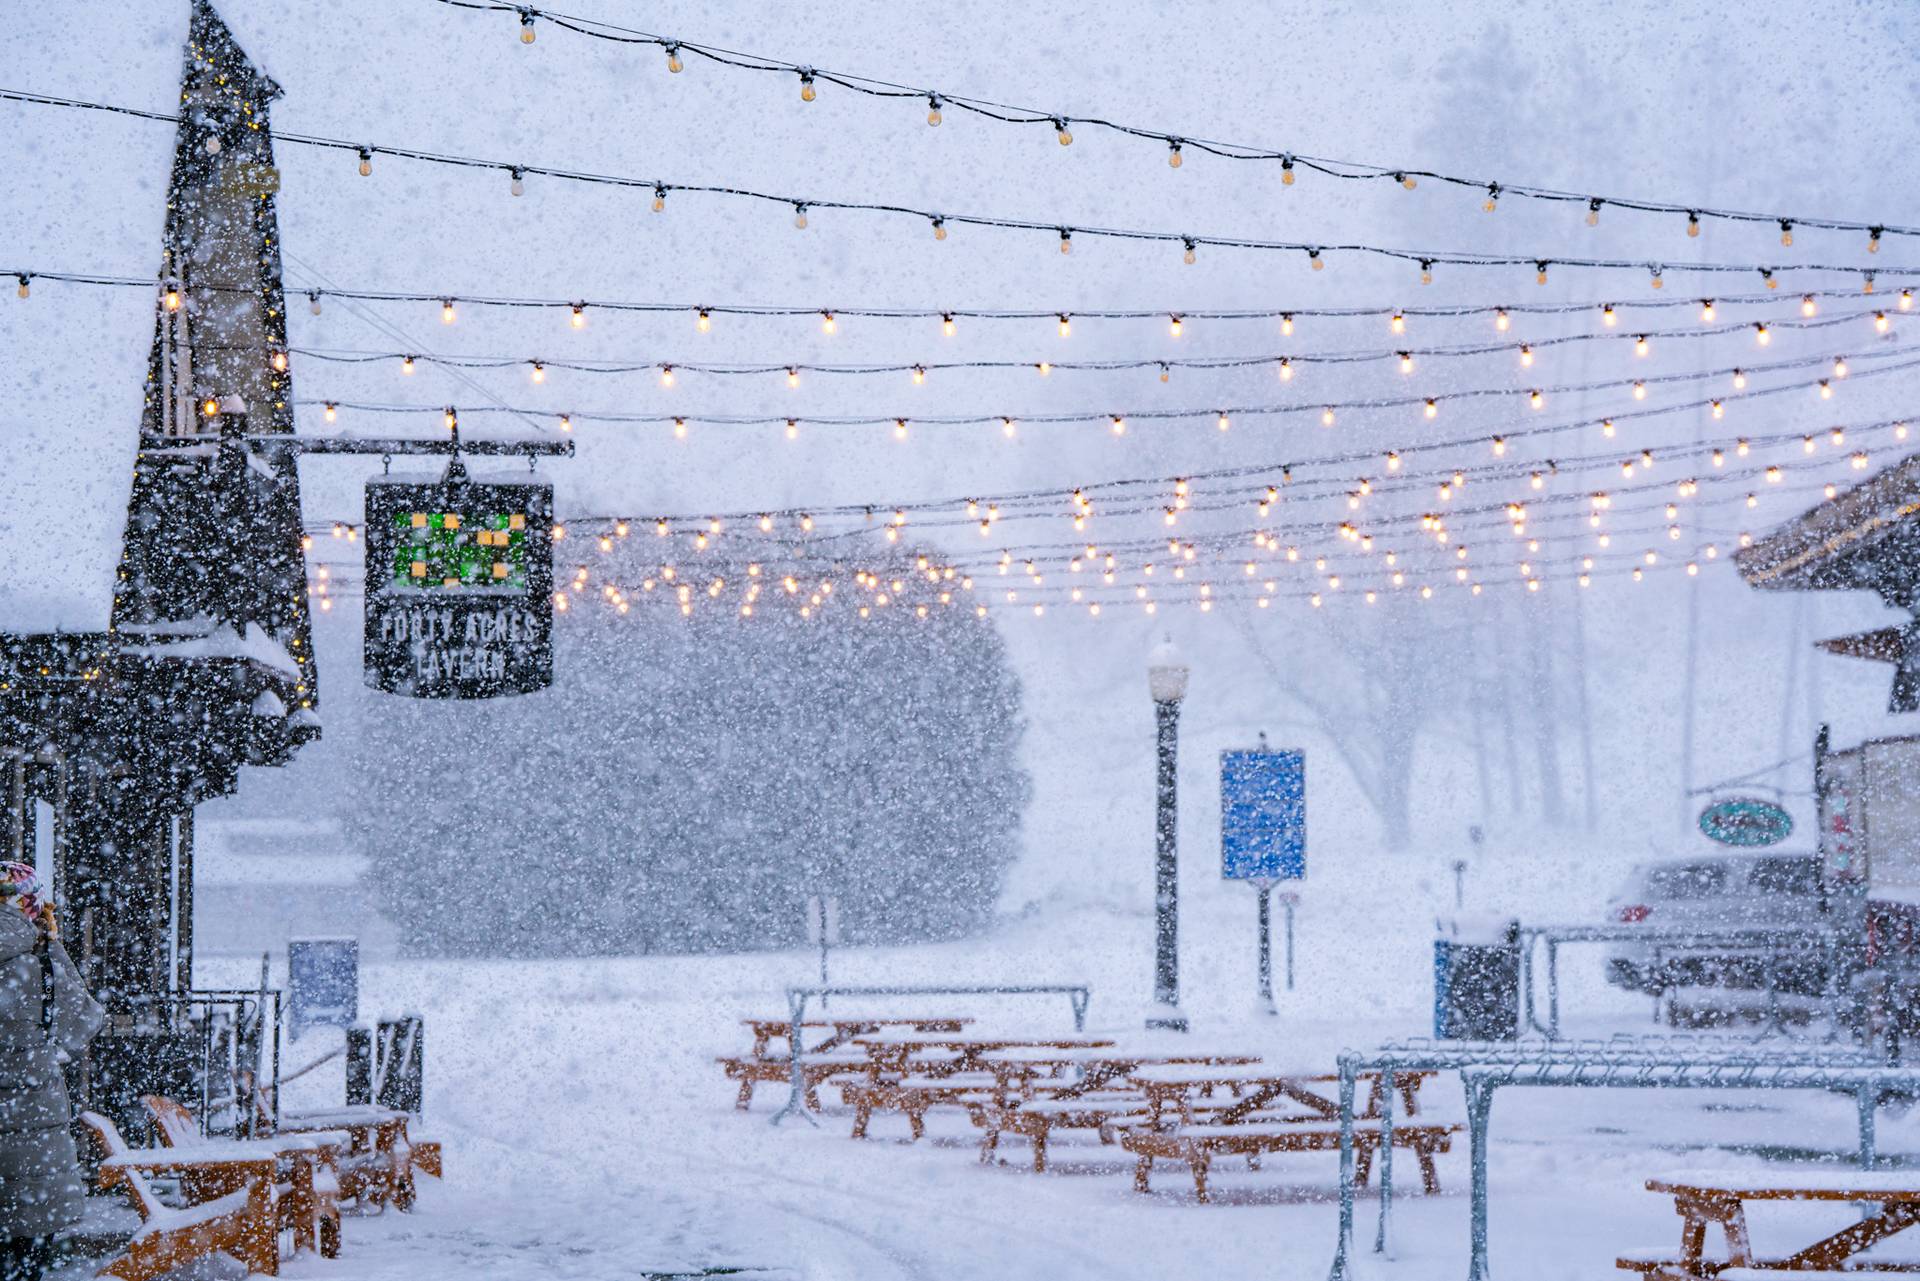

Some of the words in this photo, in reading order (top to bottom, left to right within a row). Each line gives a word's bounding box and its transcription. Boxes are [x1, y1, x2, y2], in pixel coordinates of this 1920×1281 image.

[381, 609, 453, 642] FORTY
[464, 609, 536, 642] ACRES
[415, 648, 505, 680] TAVERN
[44, 970, 53, 1001] SOY
